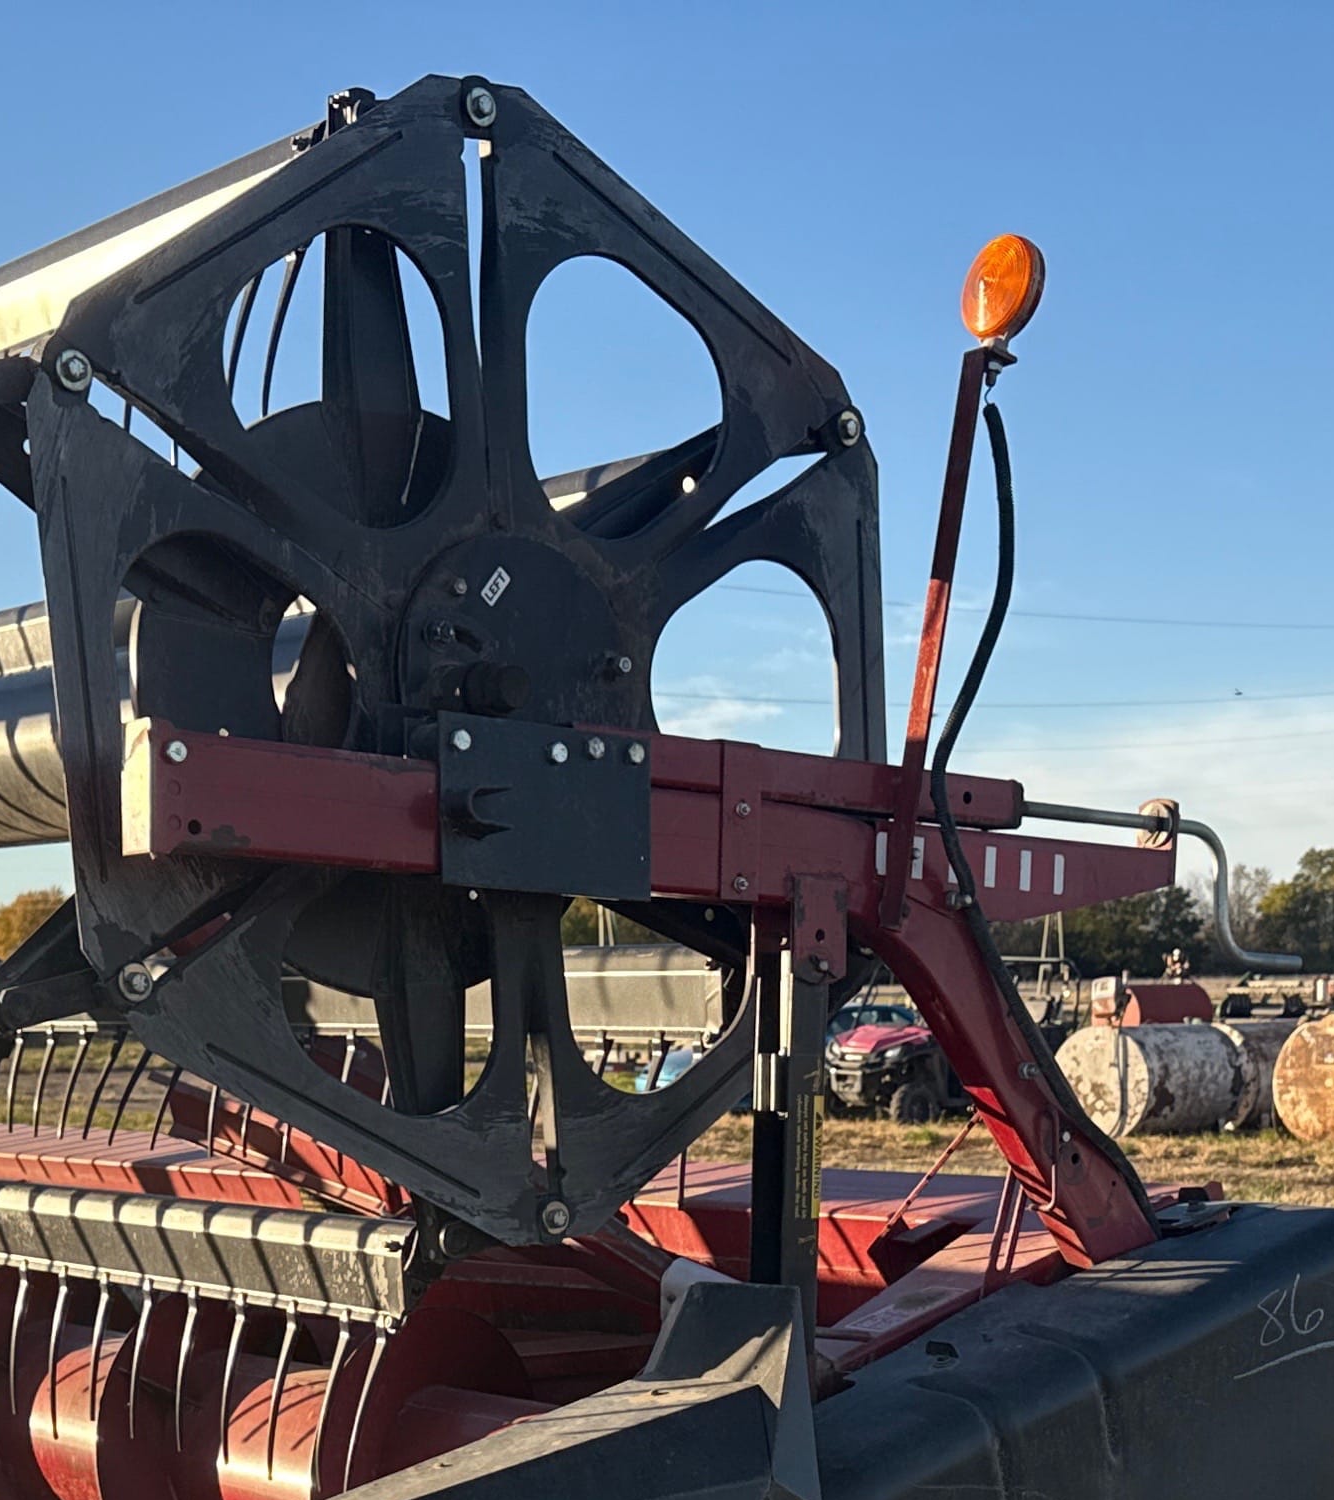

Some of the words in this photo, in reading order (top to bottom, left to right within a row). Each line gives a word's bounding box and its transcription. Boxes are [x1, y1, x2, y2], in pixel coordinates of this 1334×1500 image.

[483, 571, 506, 601] LEFT
[813, 1135, 822, 1199] WARNING
[1257, 1273, 1324, 1346] 86
